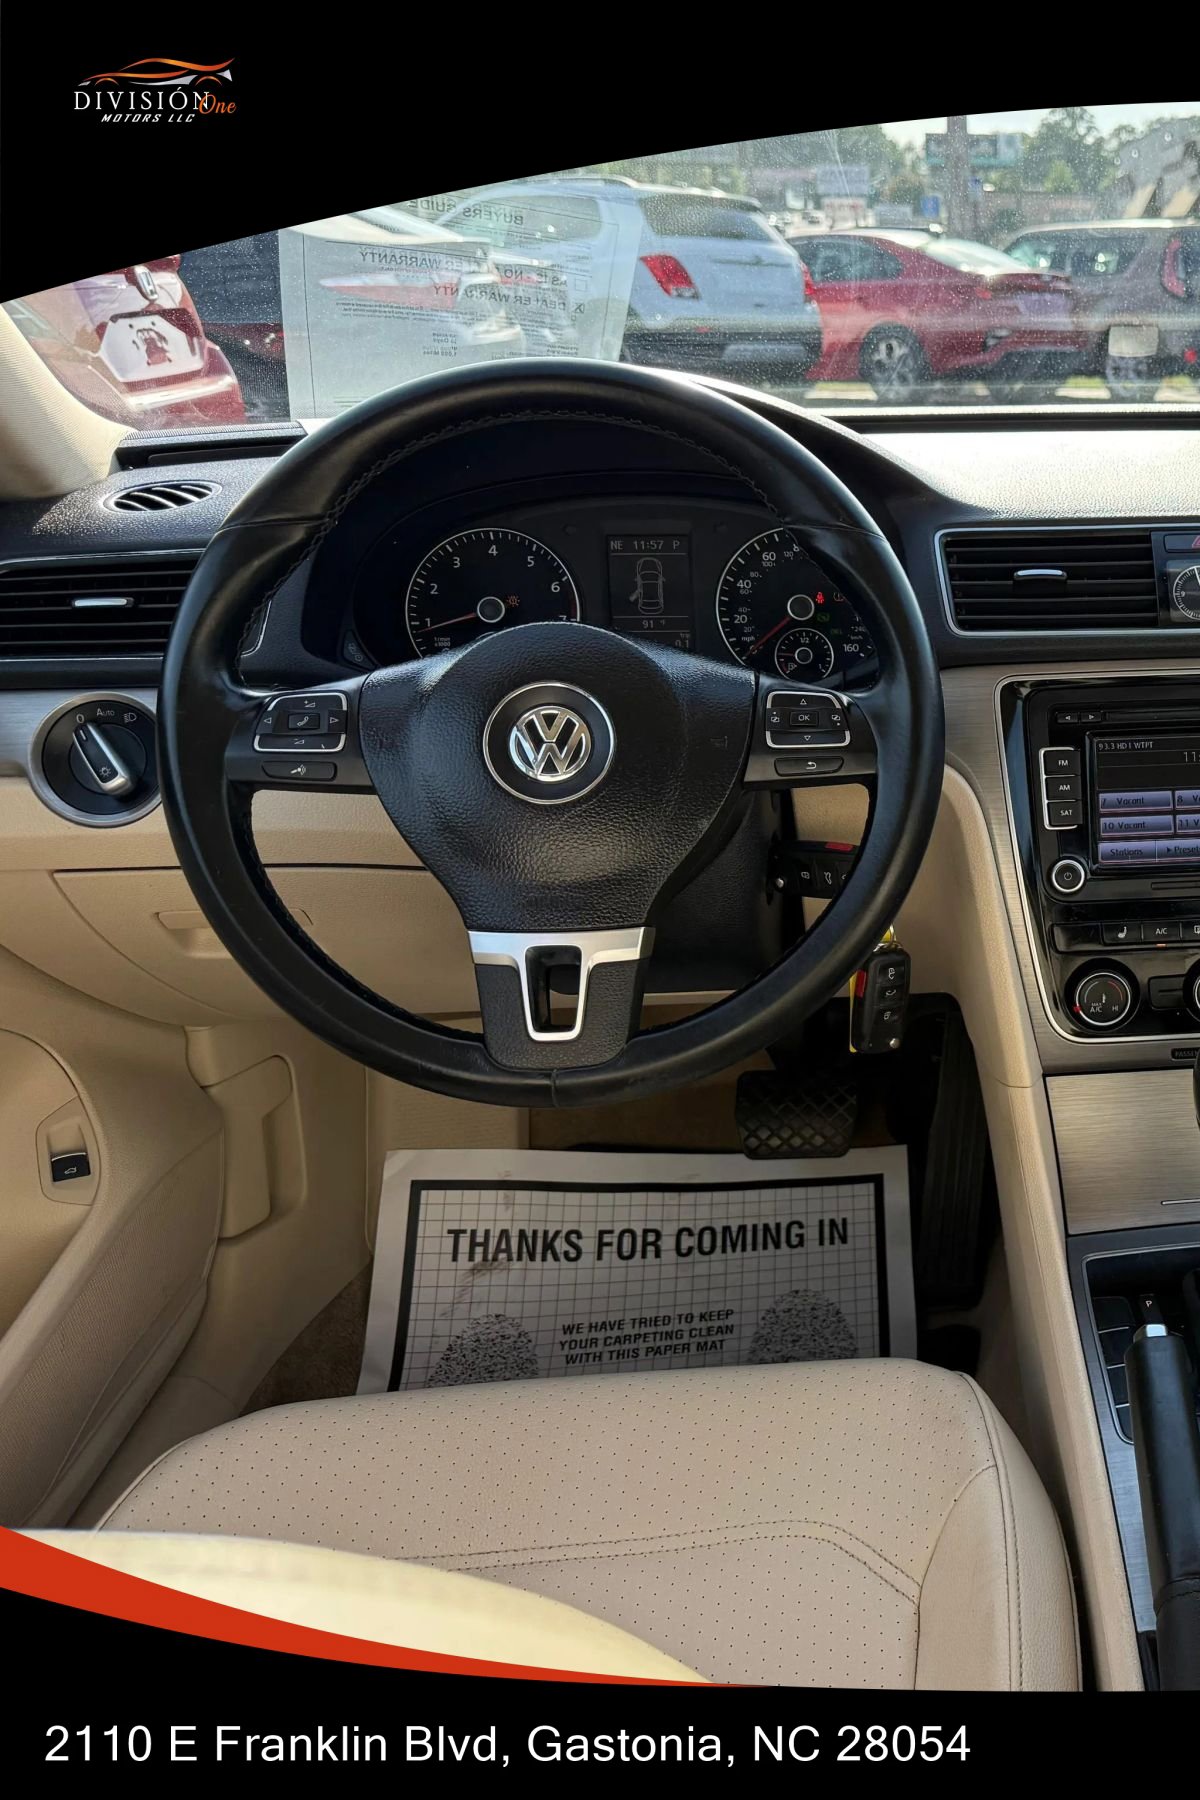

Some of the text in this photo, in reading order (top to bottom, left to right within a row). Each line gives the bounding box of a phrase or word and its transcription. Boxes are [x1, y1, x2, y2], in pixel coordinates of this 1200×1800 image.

[488, 544, 498, 556] 4
[610, 540, 680, 550] NE 11:57 P
[762, 551, 776, 561] 60
[452, 556, 461, 568] 3
[527, 556, 535, 568] 5
[429, 583, 439, 595] 2
[551, 582, 560, 593] 6
[736, 580, 752, 590] 40
[642, 620, 654, 628] 91
[734, 614, 748, 624] 20
[842, 644, 860, 652] 160
[96, 707, 115, 717] Auto
[1098, 742, 1115, 750] 93.3
[1116, 796, 1144, 806] Vacant
[1177, 794, 1184, 804] 8
[1060, 809, 1073, 817] SAT
[1103, 820, 1146, 830] 10 Vacant
[1110, 847, 1144, 857] Stations
[1155, 926, 1168, 936] A/C
[446, 1216, 848, 1262] THANKS FOR COMING IN
[562, 1308, 734, 1336] WE HAVE TRIED TO KEEP
[560, 1324, 735, 1351] YOUR CARPETING CLEAN
[564, 1340, 726, 1366] WITH THIS PAPER MAT
